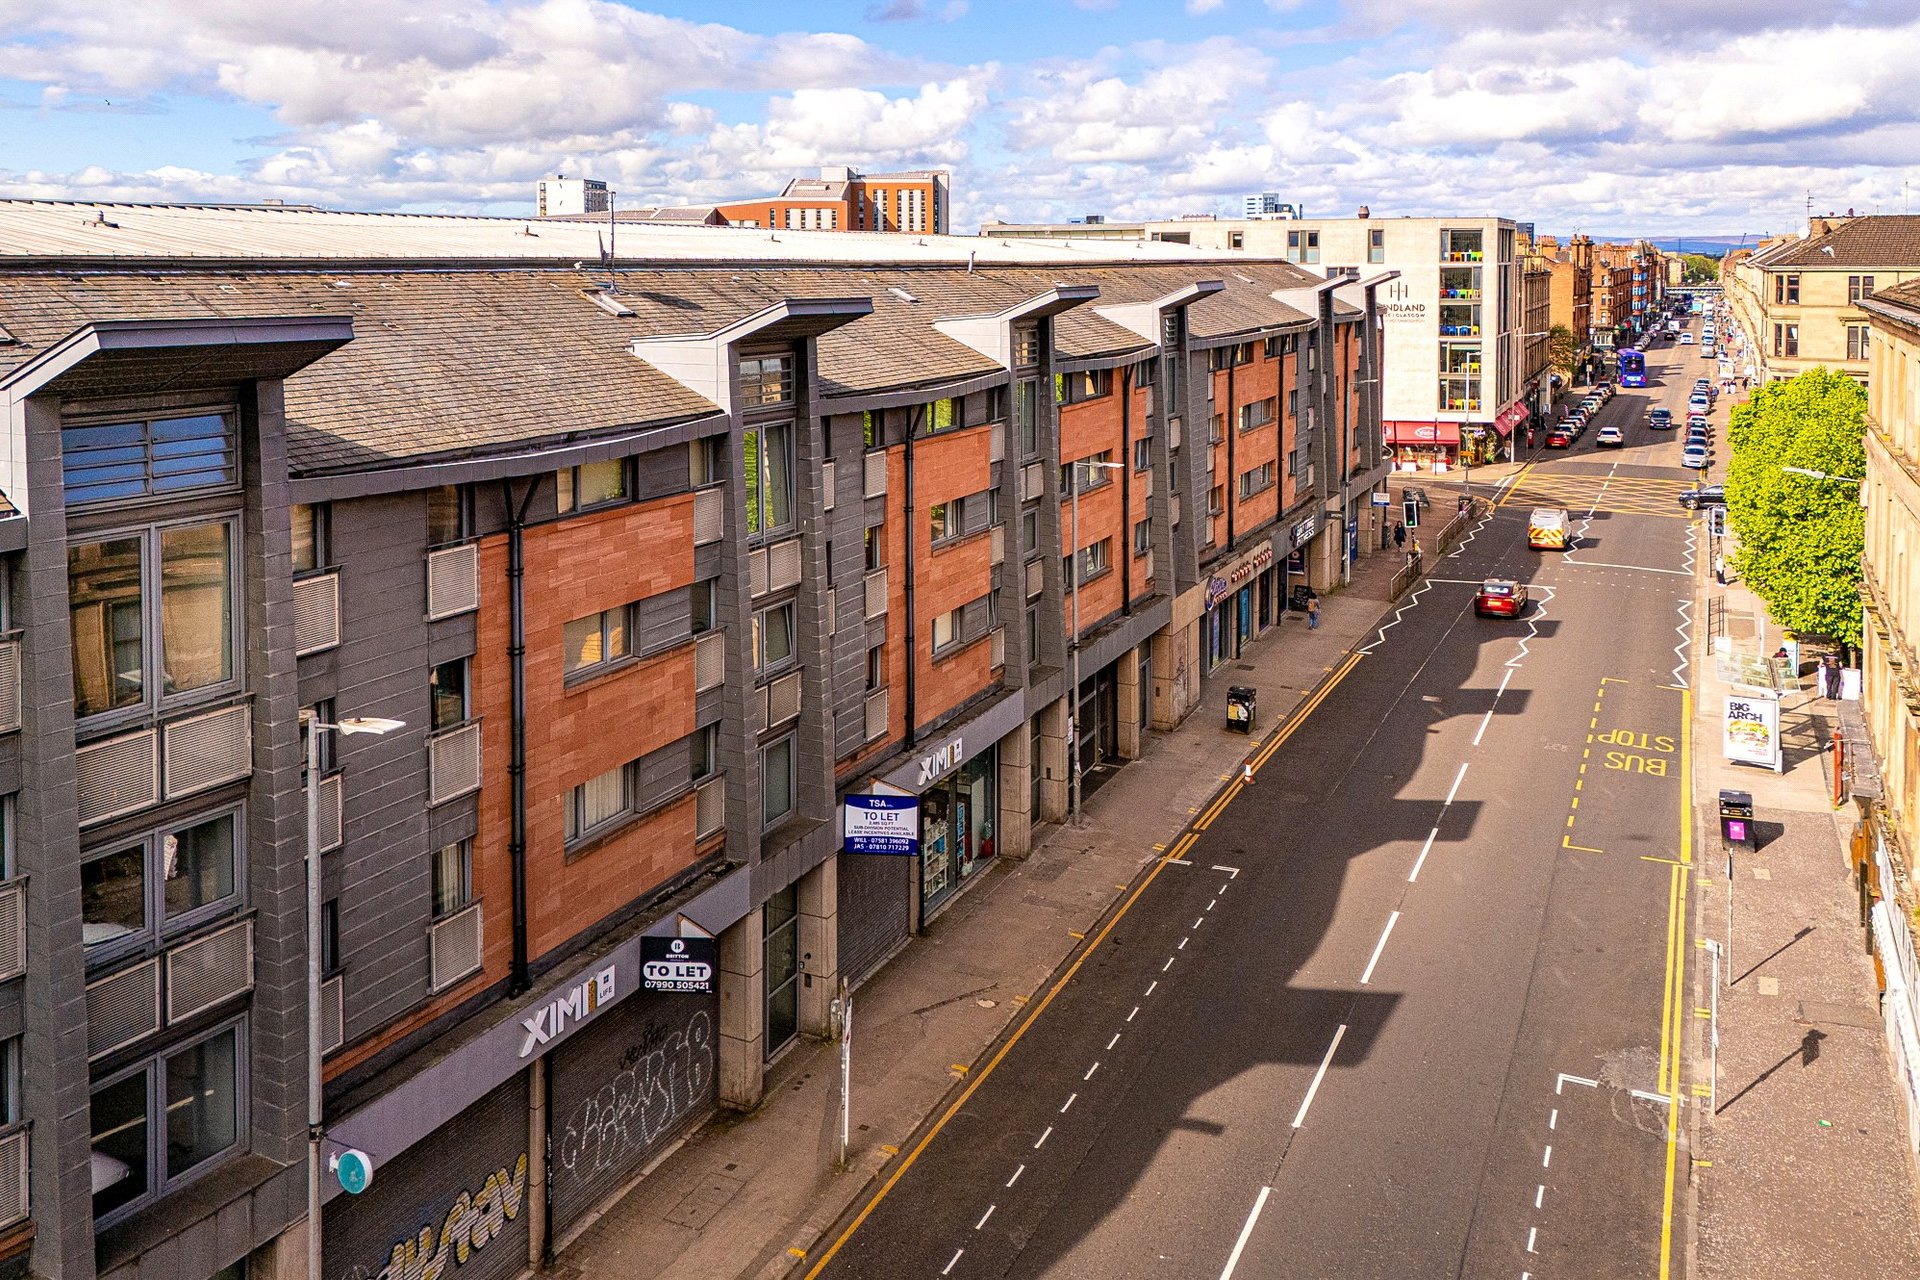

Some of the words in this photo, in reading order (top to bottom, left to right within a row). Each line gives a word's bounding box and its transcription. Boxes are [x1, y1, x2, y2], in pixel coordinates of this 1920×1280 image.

[1386, 304, 1426, 312] NDLAND
[1729, 702, 1751, 712] BIG
[1728, 711, 1763, 722] ARCH
[1597, 729, 1675, 753] STOP
[1603, 751, 1667, 777] BUS
[869, 799, 887, 807] TSA
[863, 811, 878, 821] TO
[880, 812, 900, 821] LET
[646, 964, 670, 977] TO
[675, 966, 707, 978] LET
[644, 980, 674, 989] 07990
[676, 981, 709, 990] 505421
[600, 985, 613, 999] LIFE
